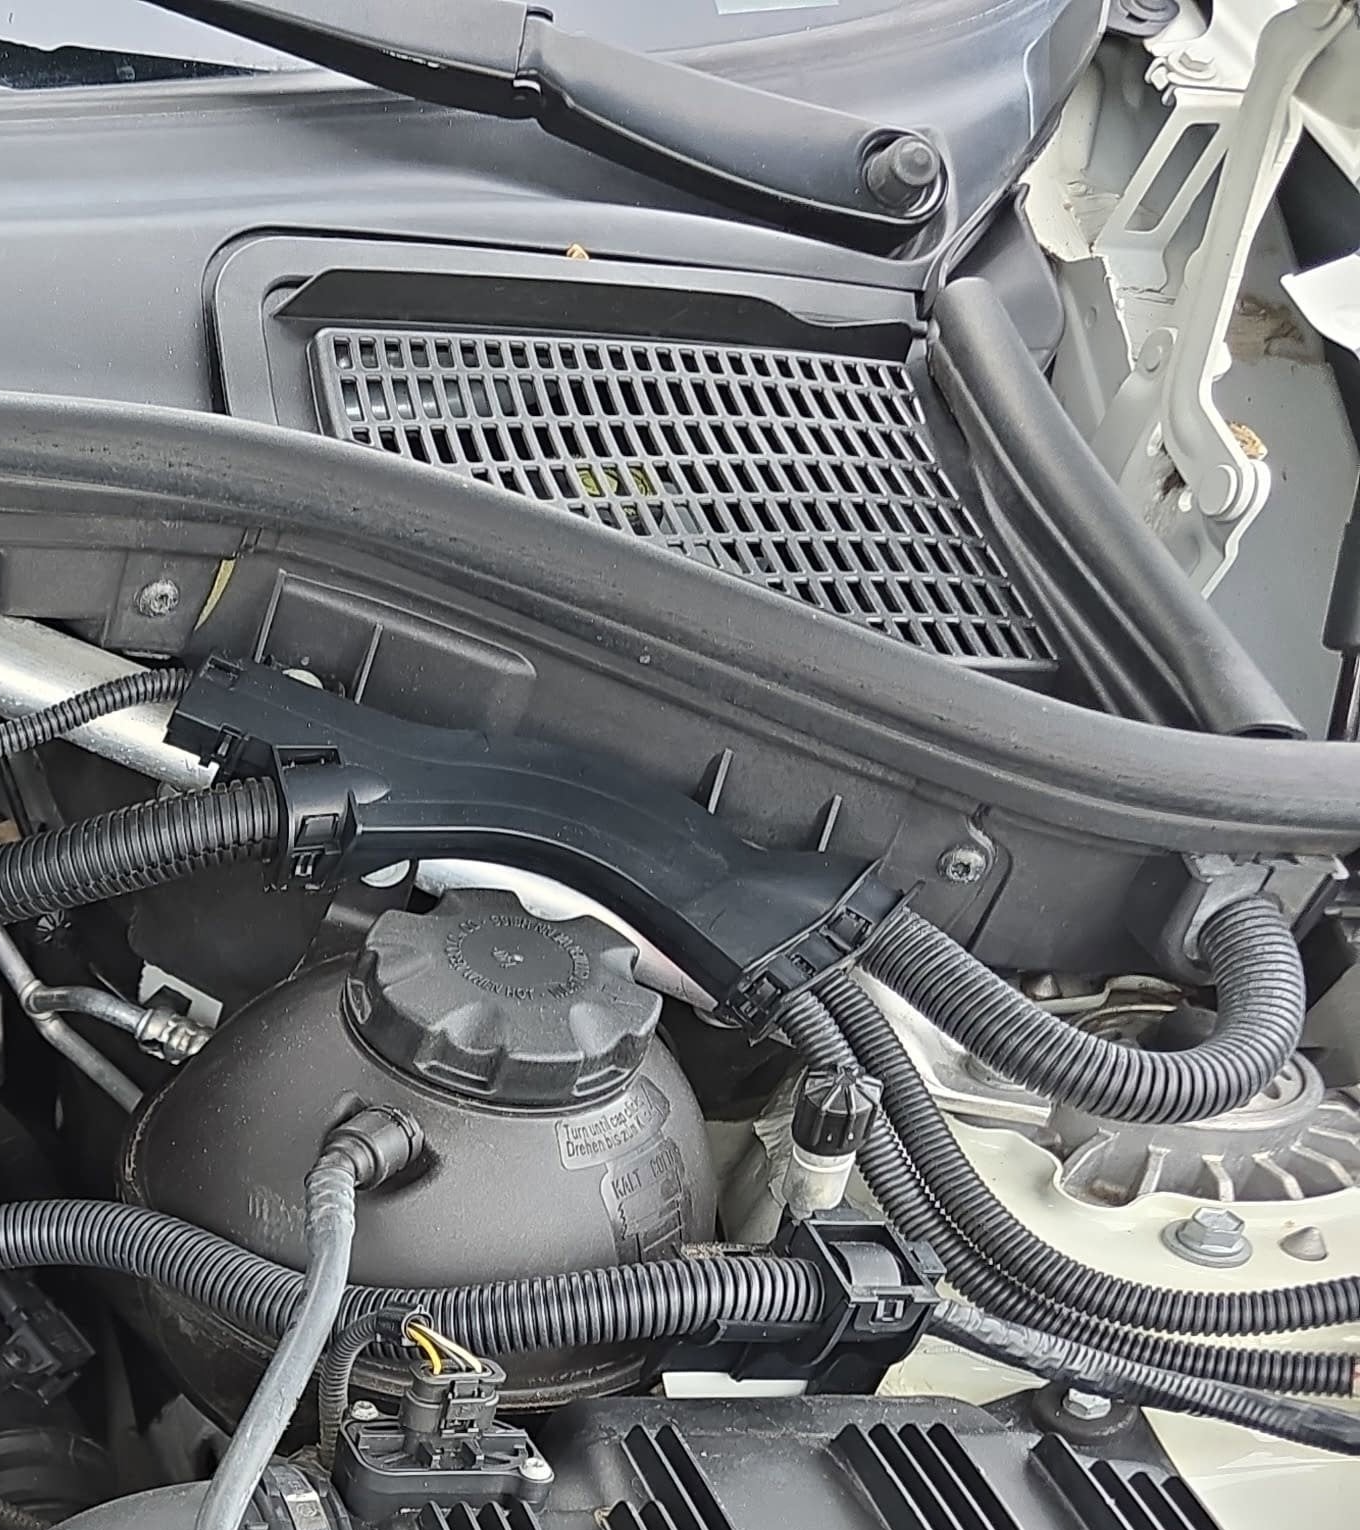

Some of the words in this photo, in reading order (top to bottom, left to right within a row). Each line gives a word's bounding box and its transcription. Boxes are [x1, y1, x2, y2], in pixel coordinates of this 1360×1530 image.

[563, 1123, 589, 1141] Turn
[566, 1138, 605, 1158] Drehen
[611, 1167, 642, 1200] KALT
